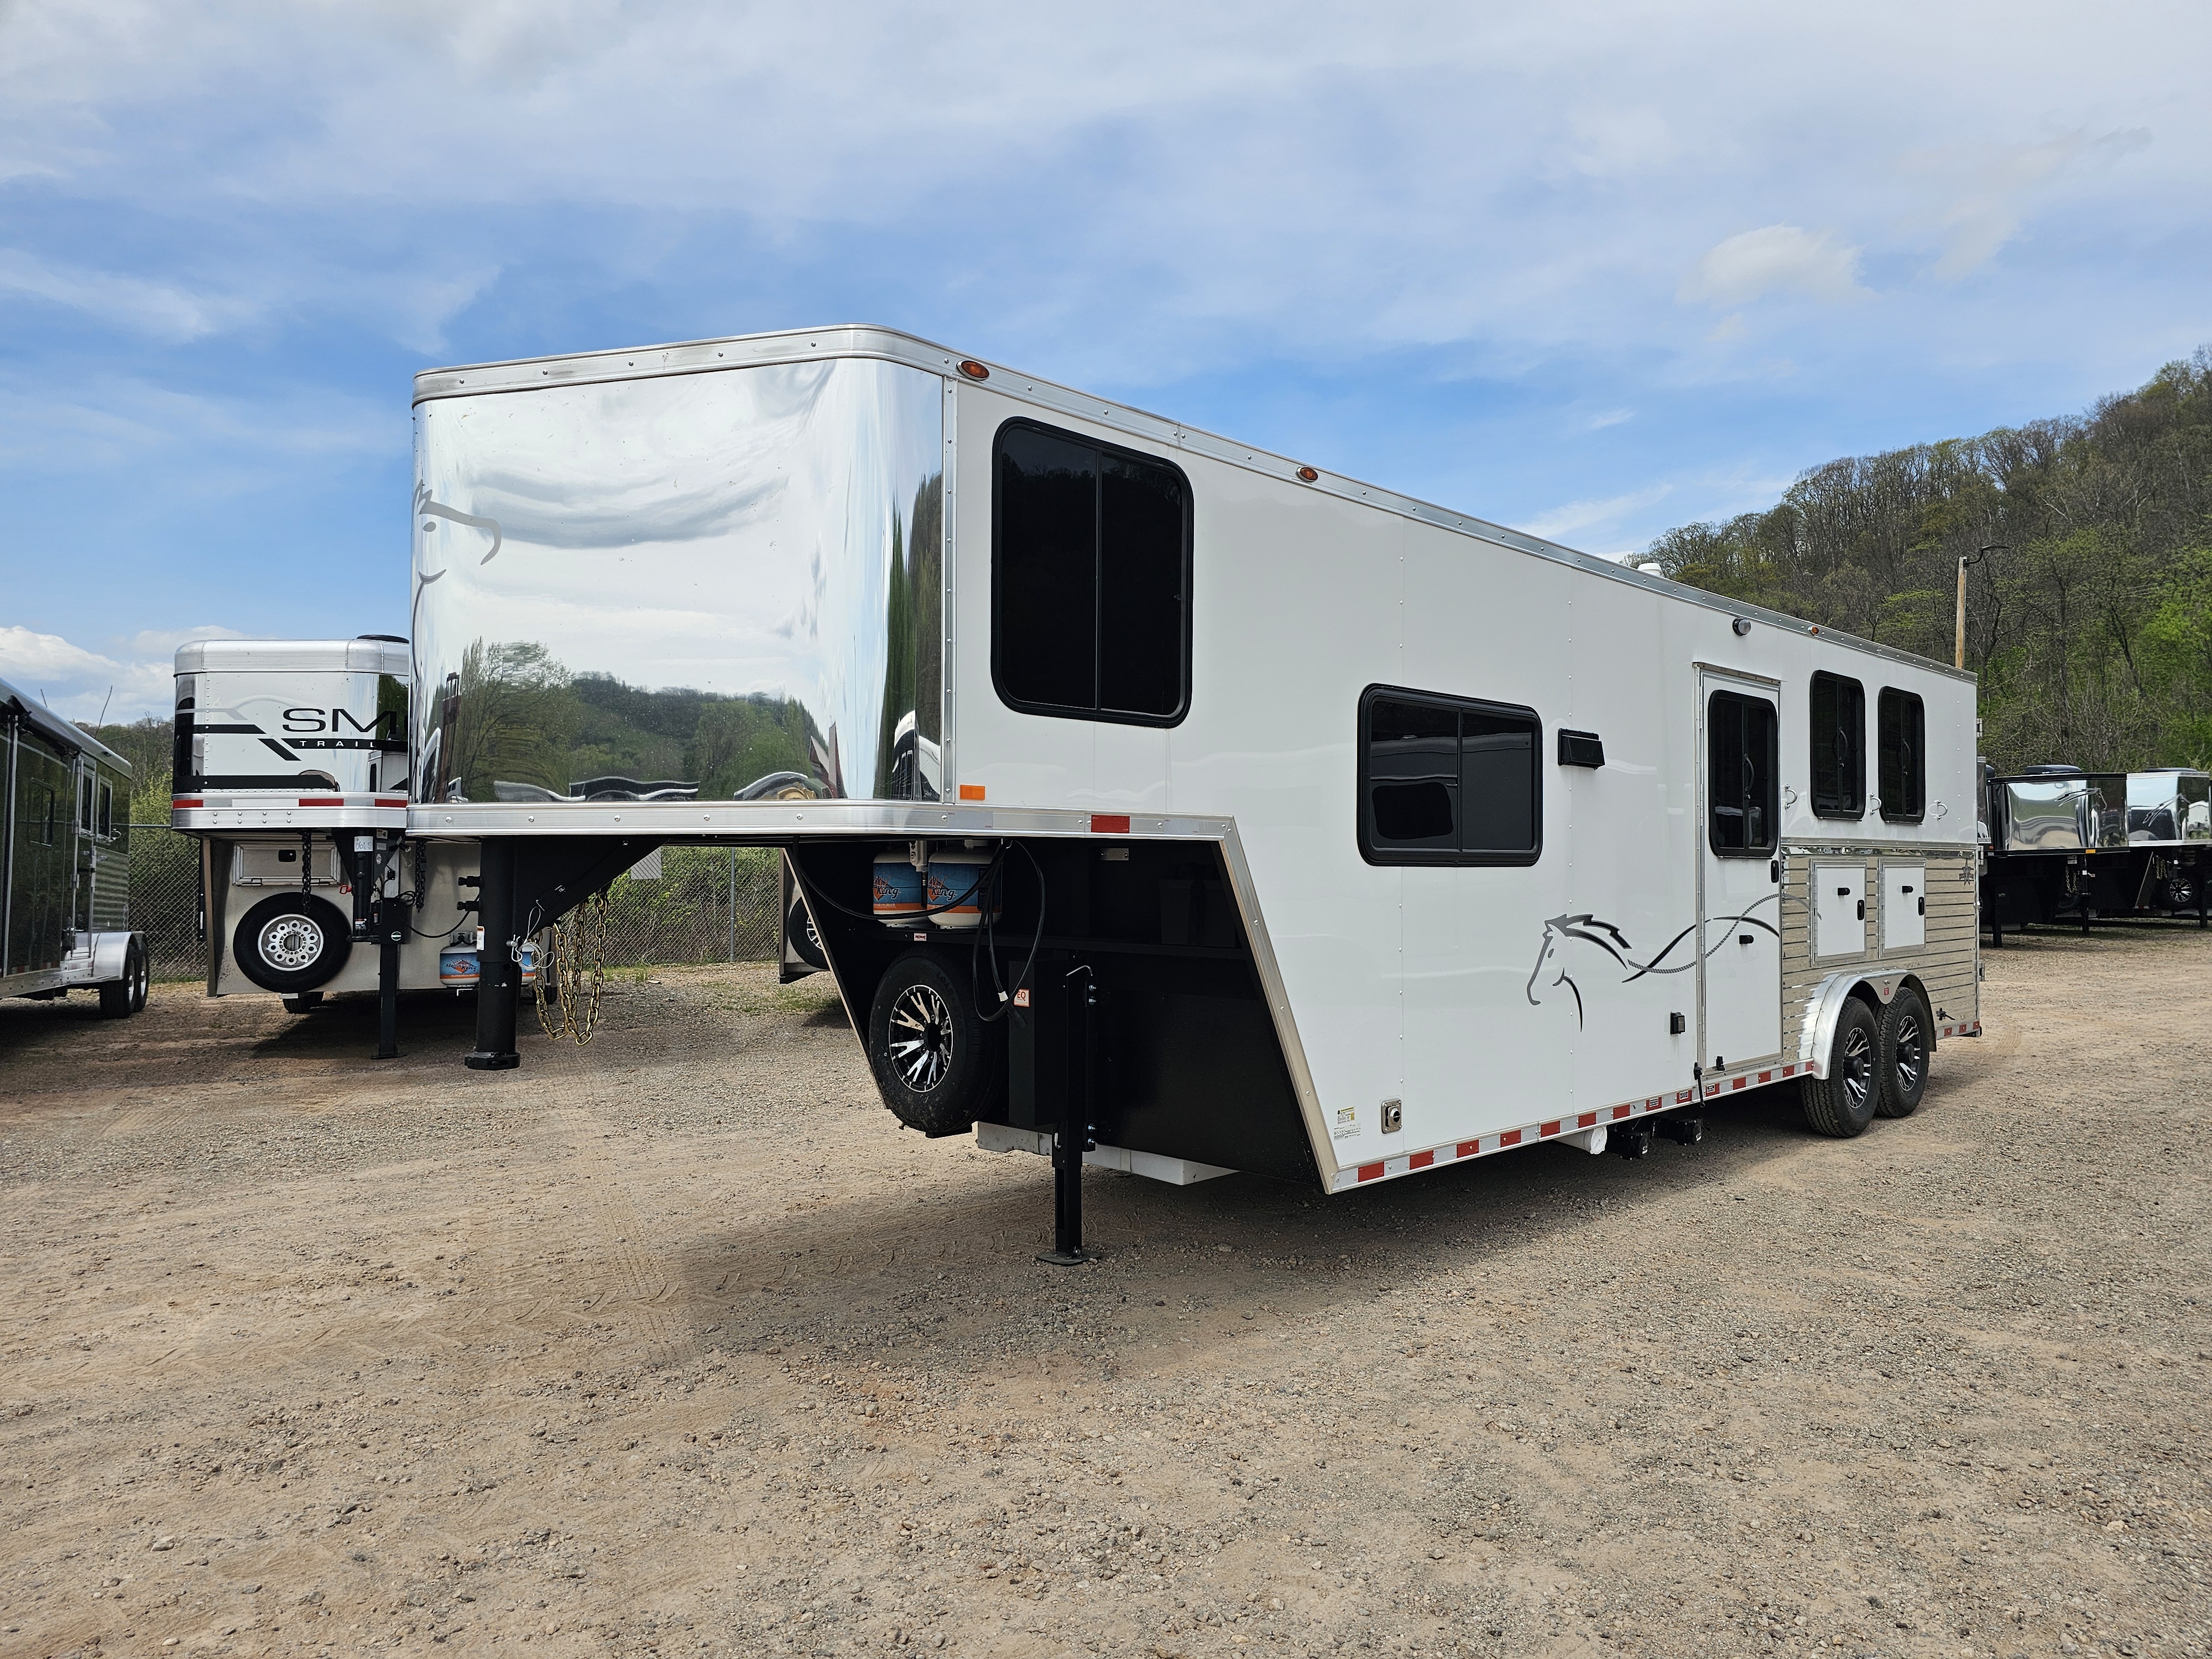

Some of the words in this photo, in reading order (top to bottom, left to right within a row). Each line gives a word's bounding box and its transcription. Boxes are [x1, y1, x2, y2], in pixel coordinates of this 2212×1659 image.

[282, 708, 408, 734] SM
[877, 885, 900, 899] King
[932, 886, 957, 901] King
